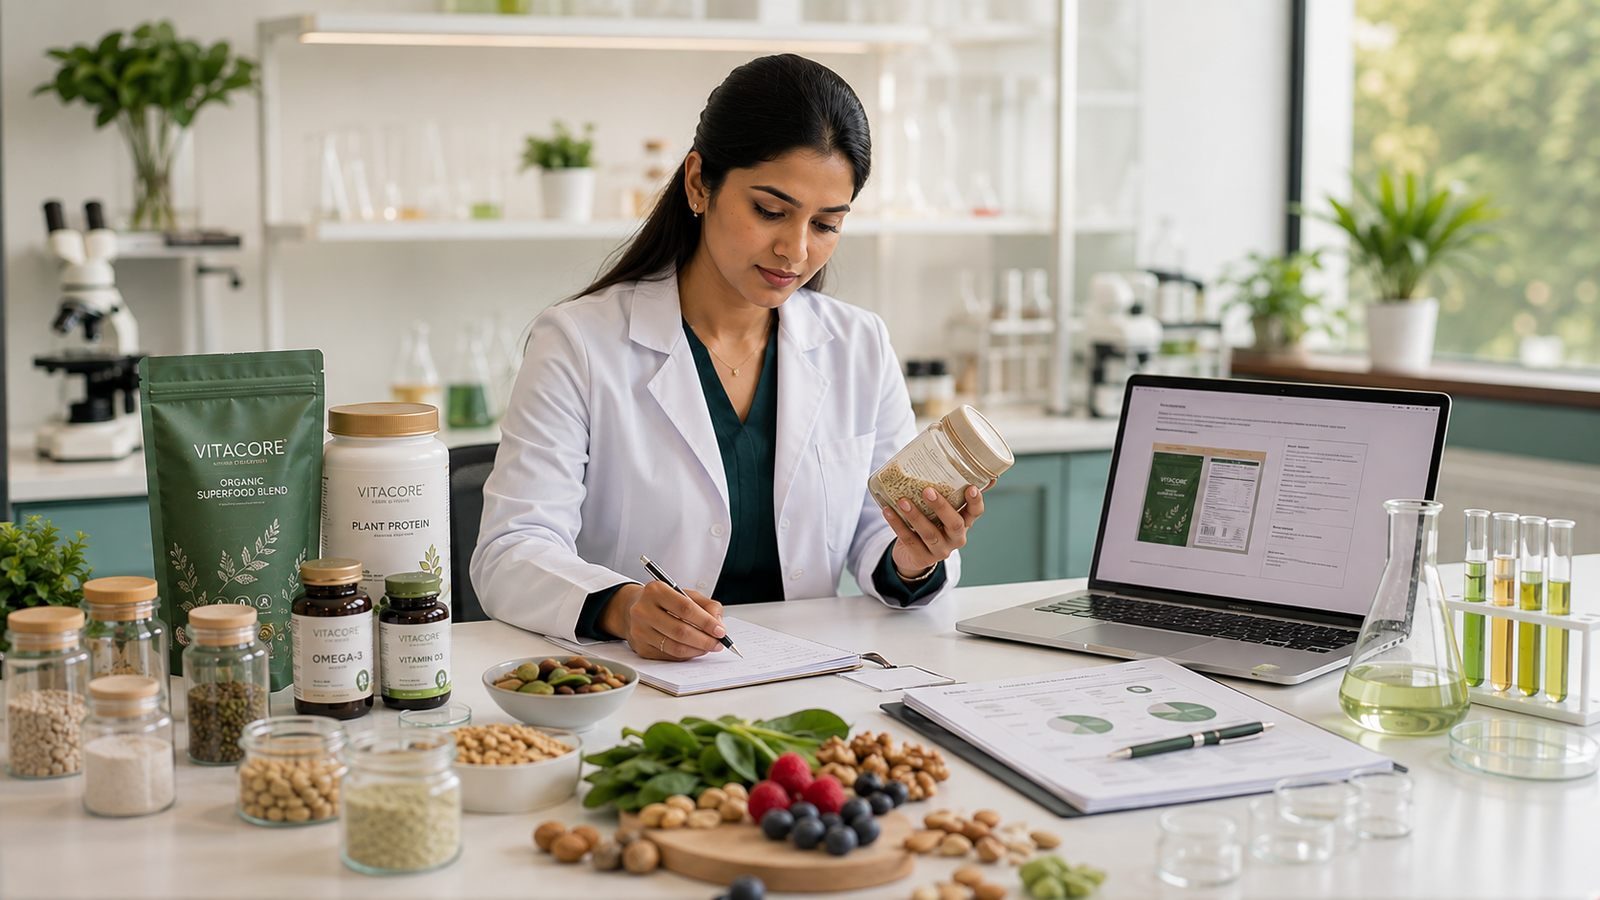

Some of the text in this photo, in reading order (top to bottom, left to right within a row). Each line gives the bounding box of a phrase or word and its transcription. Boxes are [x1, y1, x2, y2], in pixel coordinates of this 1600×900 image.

[193, 439, 285, 459] VITACORE
[219, 476, 264, 487] ORGANIC
[196, 486, 288, 500] SUPERFOOD BLEND
[357, 484, 423, 498] VITACORE
[352, 519, 430, 531] PLANT PROTEIN
[312, 626, 359, 638] VITACORE
[398, 632, 440, 643] VITACORE
[312, 651, 363, 664] OMEGA-3
[398, 653, 444, 664] VITAMIN D3
